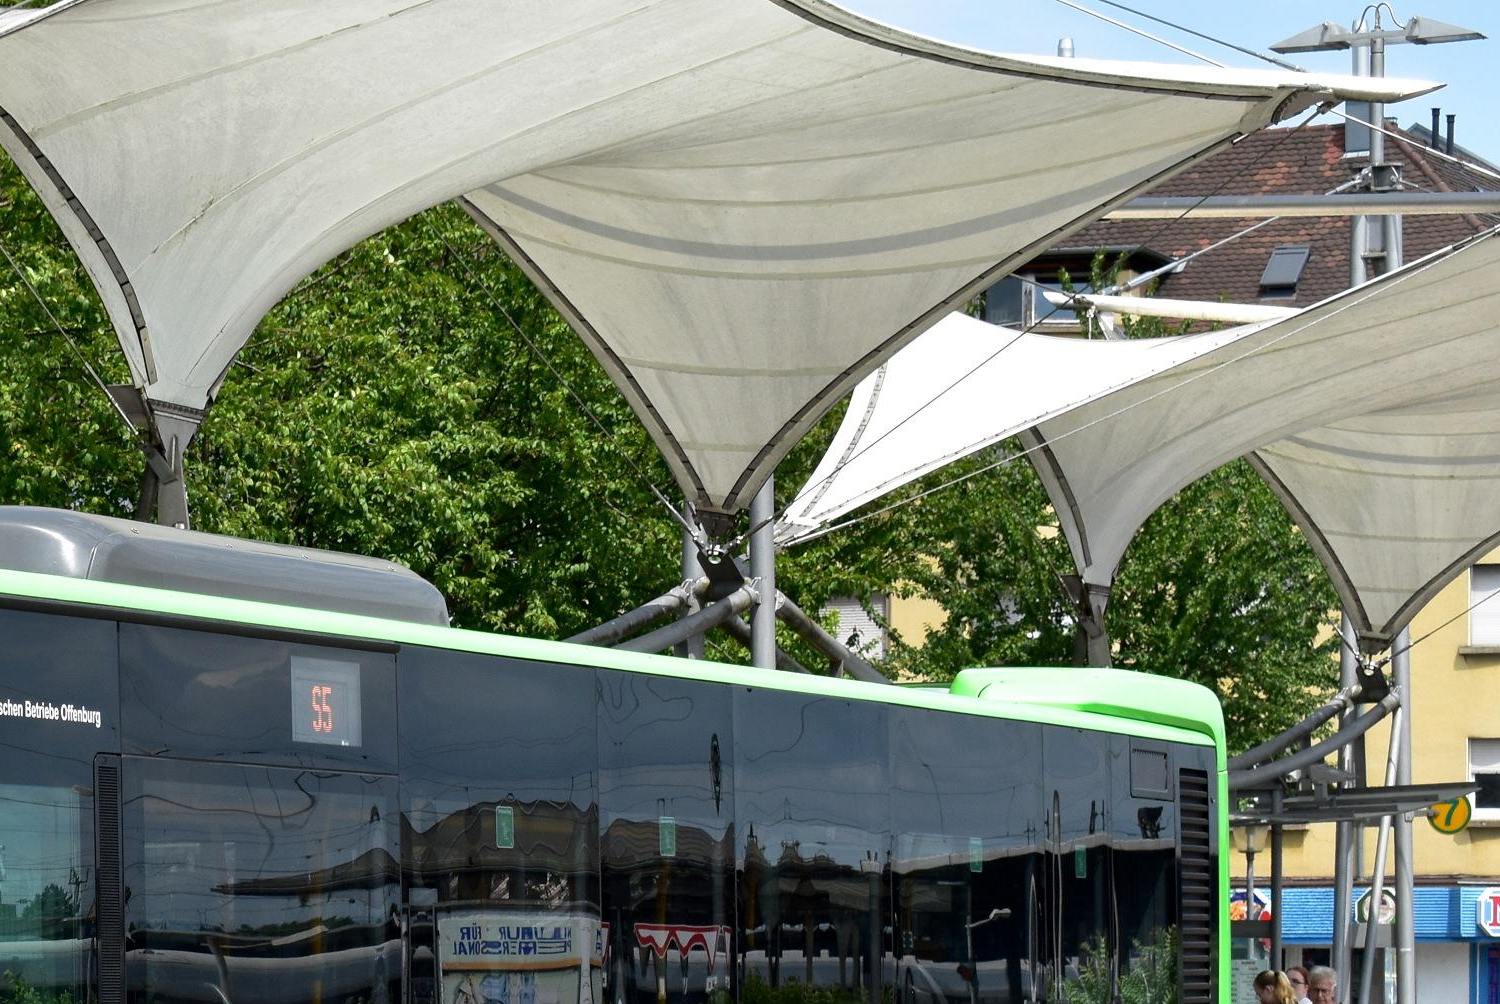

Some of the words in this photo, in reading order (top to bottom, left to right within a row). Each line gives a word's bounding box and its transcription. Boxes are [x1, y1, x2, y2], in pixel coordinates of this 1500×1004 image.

[25, 700, 59, 721] Betriebe
[60, 704, 102, 728] Offenburg
[310, 685, 334, 733] S5
[1444, 799, 1460, 827] 7
